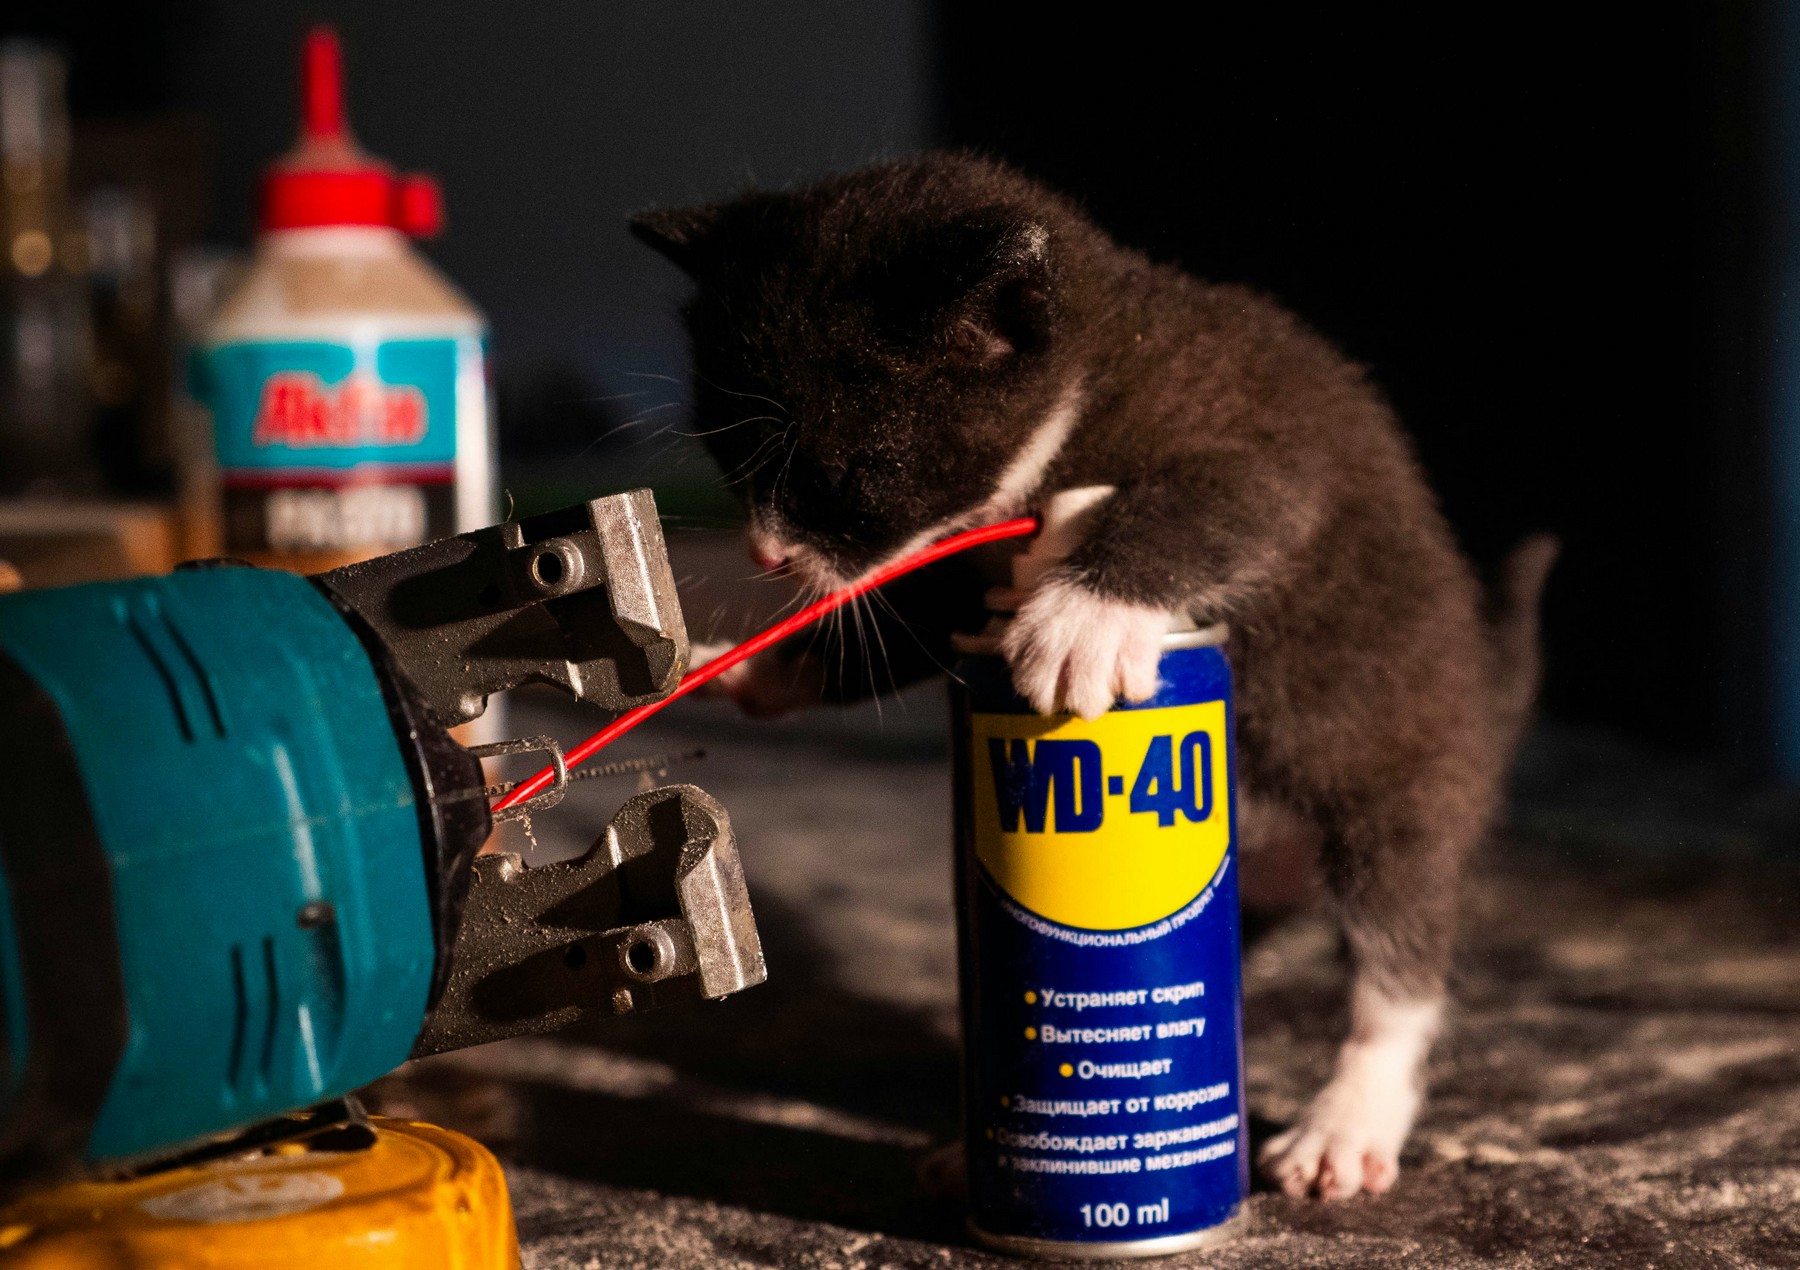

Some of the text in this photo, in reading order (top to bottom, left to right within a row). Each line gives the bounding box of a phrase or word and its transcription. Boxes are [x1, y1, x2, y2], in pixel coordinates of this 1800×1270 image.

[988, 731, 1213, 834] WD-40
[1041, 982, 1205, 1011] Устраняет скрип
[1041, 1017, 1206, 1043] Вытесняет влагу
[1077, 1058, 1172, 1080] Очищает
[1012, 1082, 1229, 1118] Защищает от коррозии
[1133, 1113, 1239, 1151] заржавевшие
[1145, 1139, 1236, 1171] механизмы
[1080, 1198, 1169, 1228] 100 ml
